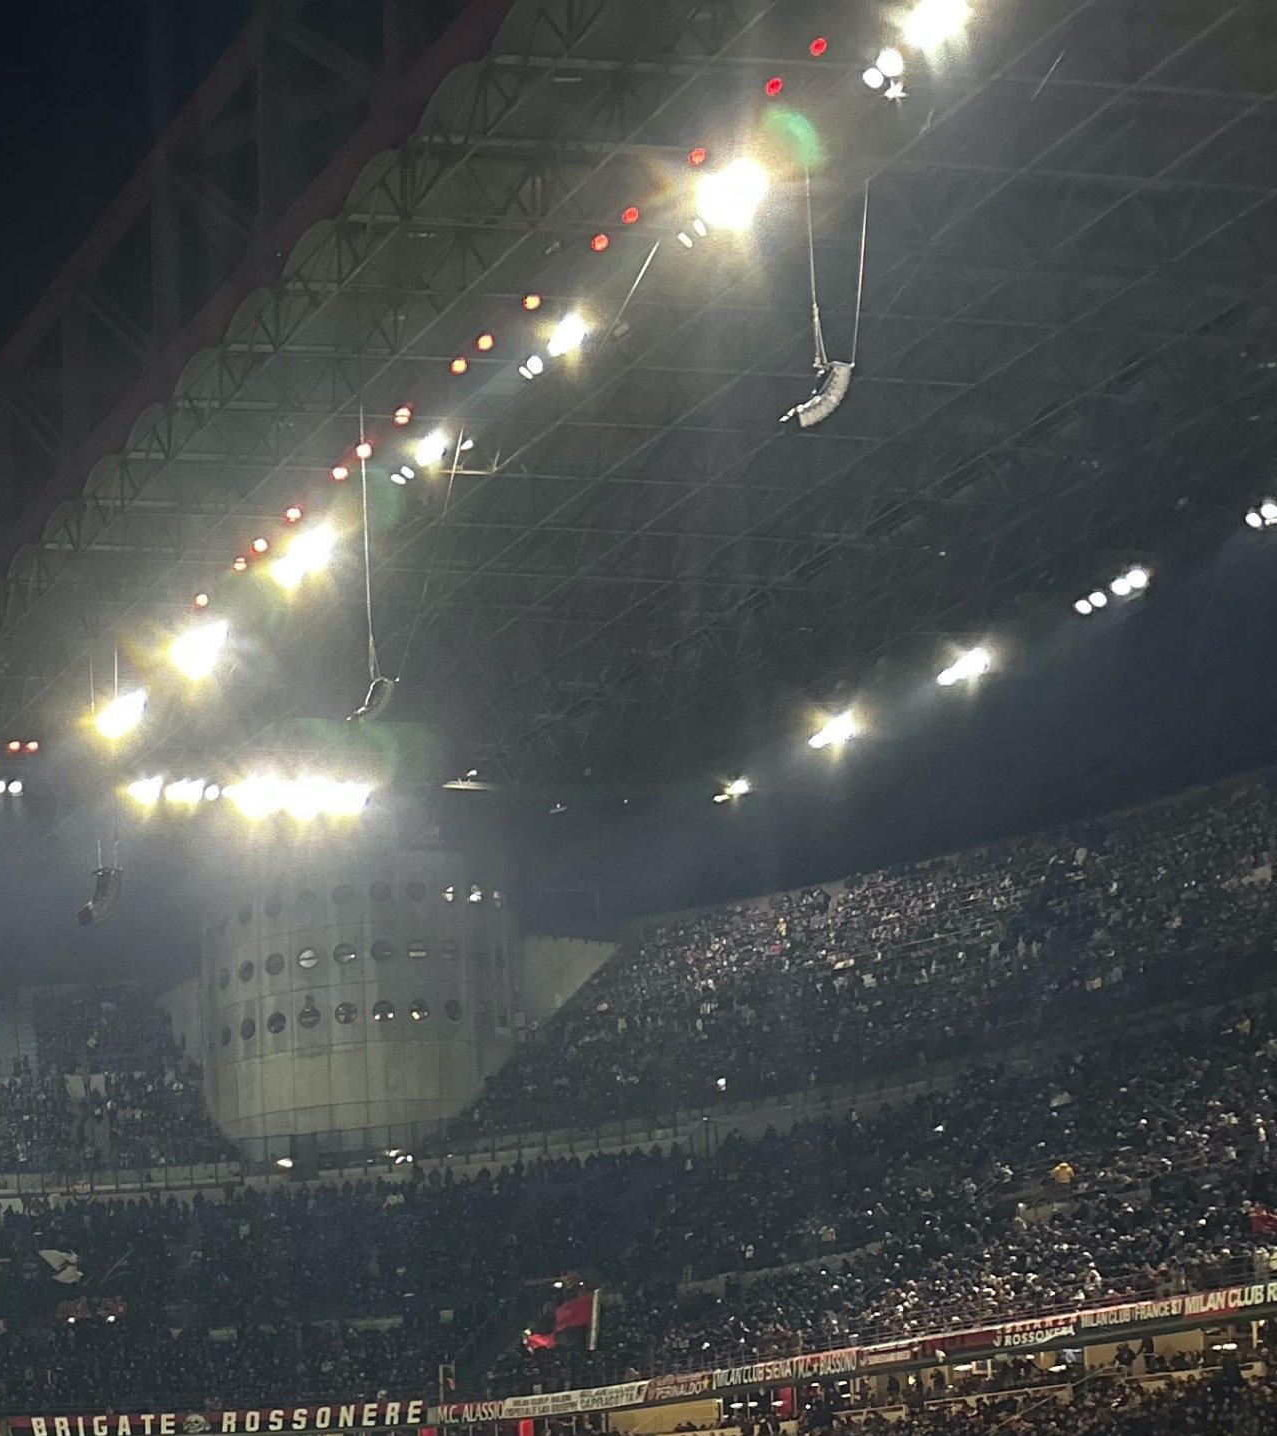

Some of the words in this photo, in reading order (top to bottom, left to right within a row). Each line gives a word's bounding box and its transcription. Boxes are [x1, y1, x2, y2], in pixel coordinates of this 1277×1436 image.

[1184, 1290, 1226, 1316] MILAN
[1227, 1284, 1265, 1308] CLUB
[221, 1400, 424, 1433] ROSSONERE
[461, 1401, 505, 1422] ALASSIO
